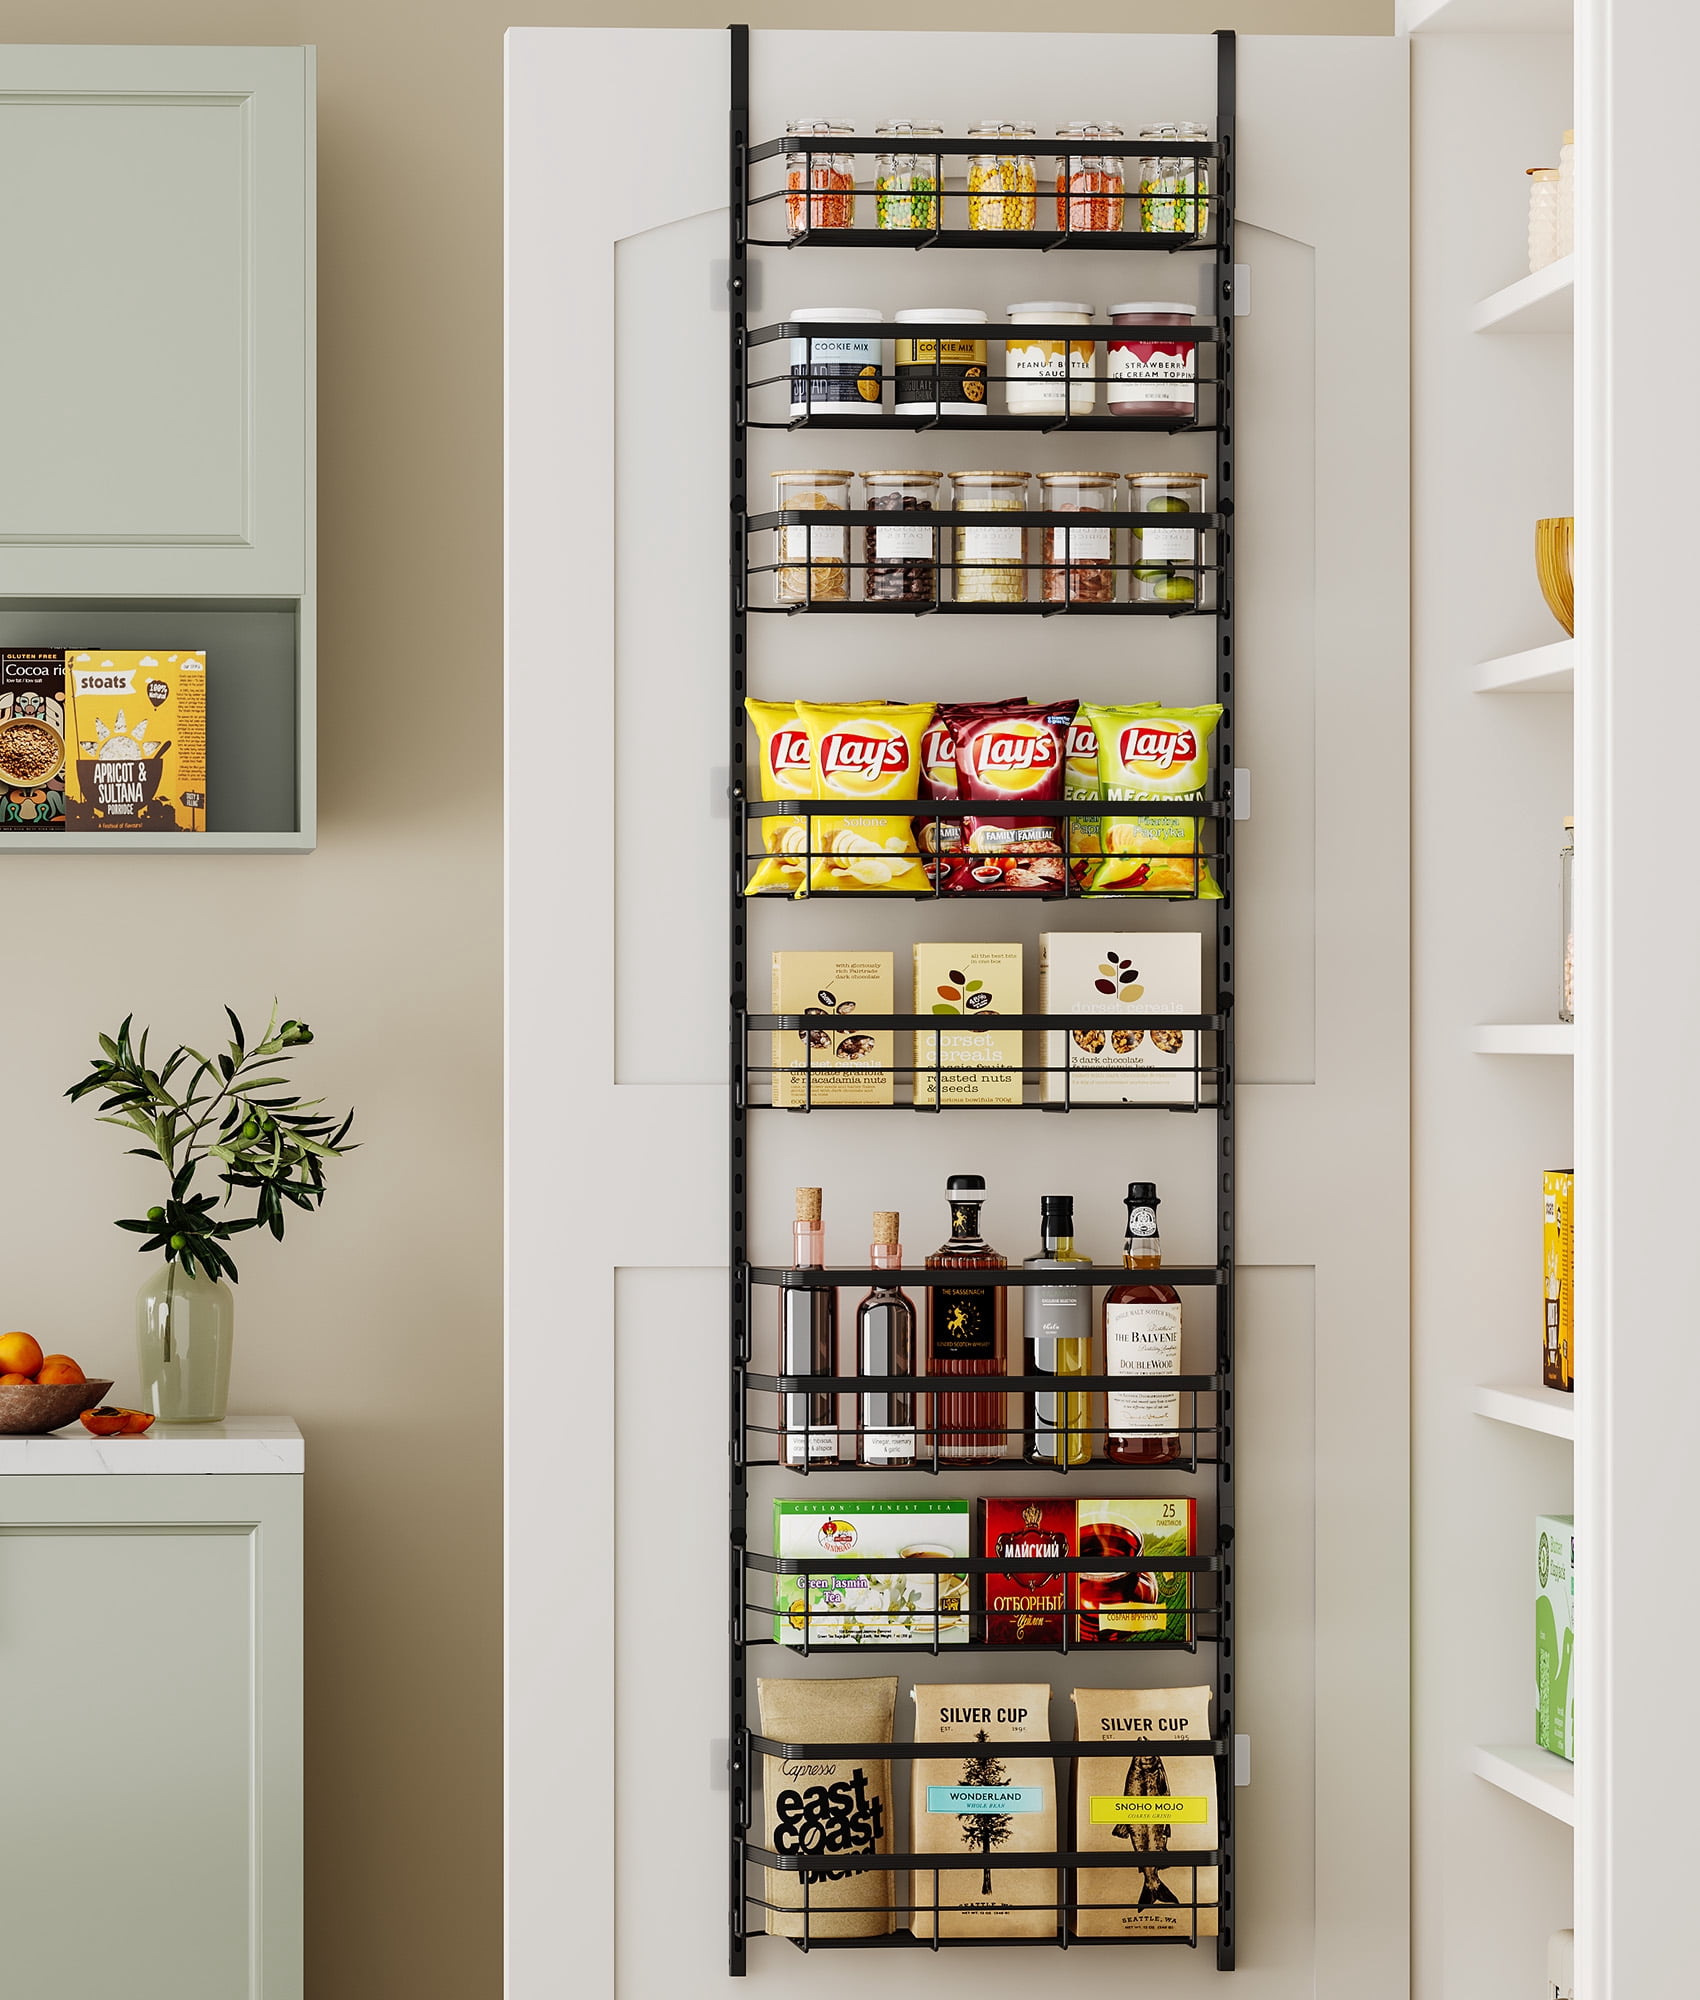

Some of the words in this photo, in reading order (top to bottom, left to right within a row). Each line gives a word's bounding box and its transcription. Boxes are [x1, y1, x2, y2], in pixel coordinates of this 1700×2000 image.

[814, 343, 850, 351] COOKIE
[958, 344, 974, 352] MIX
[1125, 362, 1187, 370] STRAWBERRY
[1039, 370, 1066, 378] SAUC
[1112, 372, 1124, 380] ICE
[793, 366, 828, 396] SUAR
[5, 663, 50, 676] Cocoa
[81, 676, 127, 690] stoats
[978, 733, 1052, 771] Lay's
[1125, 729, 1193, 770] Lay's
[825, 735, 905, 782] Lay's
[93, 762, 134, 784] APRICOT
[138, 762, 147, 782] &
[98, 782, 144, 804] SULTANA
[986, 830, 1016, 842] FAMILY
[790, 1060, 830, 1068] doset
[1072, 1056, 1078, 1064] 3
[1079, 1056, 1100, 1064] dark
[1102, 1056, 1144, 1064] chocolate
[790, 1076, 800, 1084] &
[982, 1074, 1012, 1082] nuts
[927, 1084, 938, 1093] &
[942, 1084, 979, 1093] seeds
[1115, 1333, 1130, 1342] THE
[1131, 1331, 1177, 1343] BALVENIE
[794, 1504, 861, 1512] CEYLON'S
[871, 1504, 918, 1512] FINEST
[929, 1504, 952, 1512] TEA
[1162, 1504, 1176, 1518] 25
[1004, 1542, 1060, 1558] МАЙСКИЙ
[797, 1576, 828, 1590] Green
[831, 1575, 869, 1589] Jasmin
[823, 1591, 842, 1604] Tea
[994, 1592, 1065, 1612] ОТБОРНЫЙ
[940, 1708, 992, 1723] SILVER
[997, 1708, 1028, 1723] CUP
[1101, 1718, 1153, 1732] SILVER
[1158, 1718, 1189, 1732] CUP
[778, 1758, 836, 1782] Capresso
[776, 1768, 869, 1824] east
[950, 1792, 1022, 1801] WONDERLAND
[1115, 1802, 1152, 1810] SNOHO
[1154, 1802, 1184, 1810] MOJO
[773, 1796, 884, 1855] coast
[1122, 1916, 1163, 1924] SEATTLE,
[1164, 1916, 1178, 1924] WA
